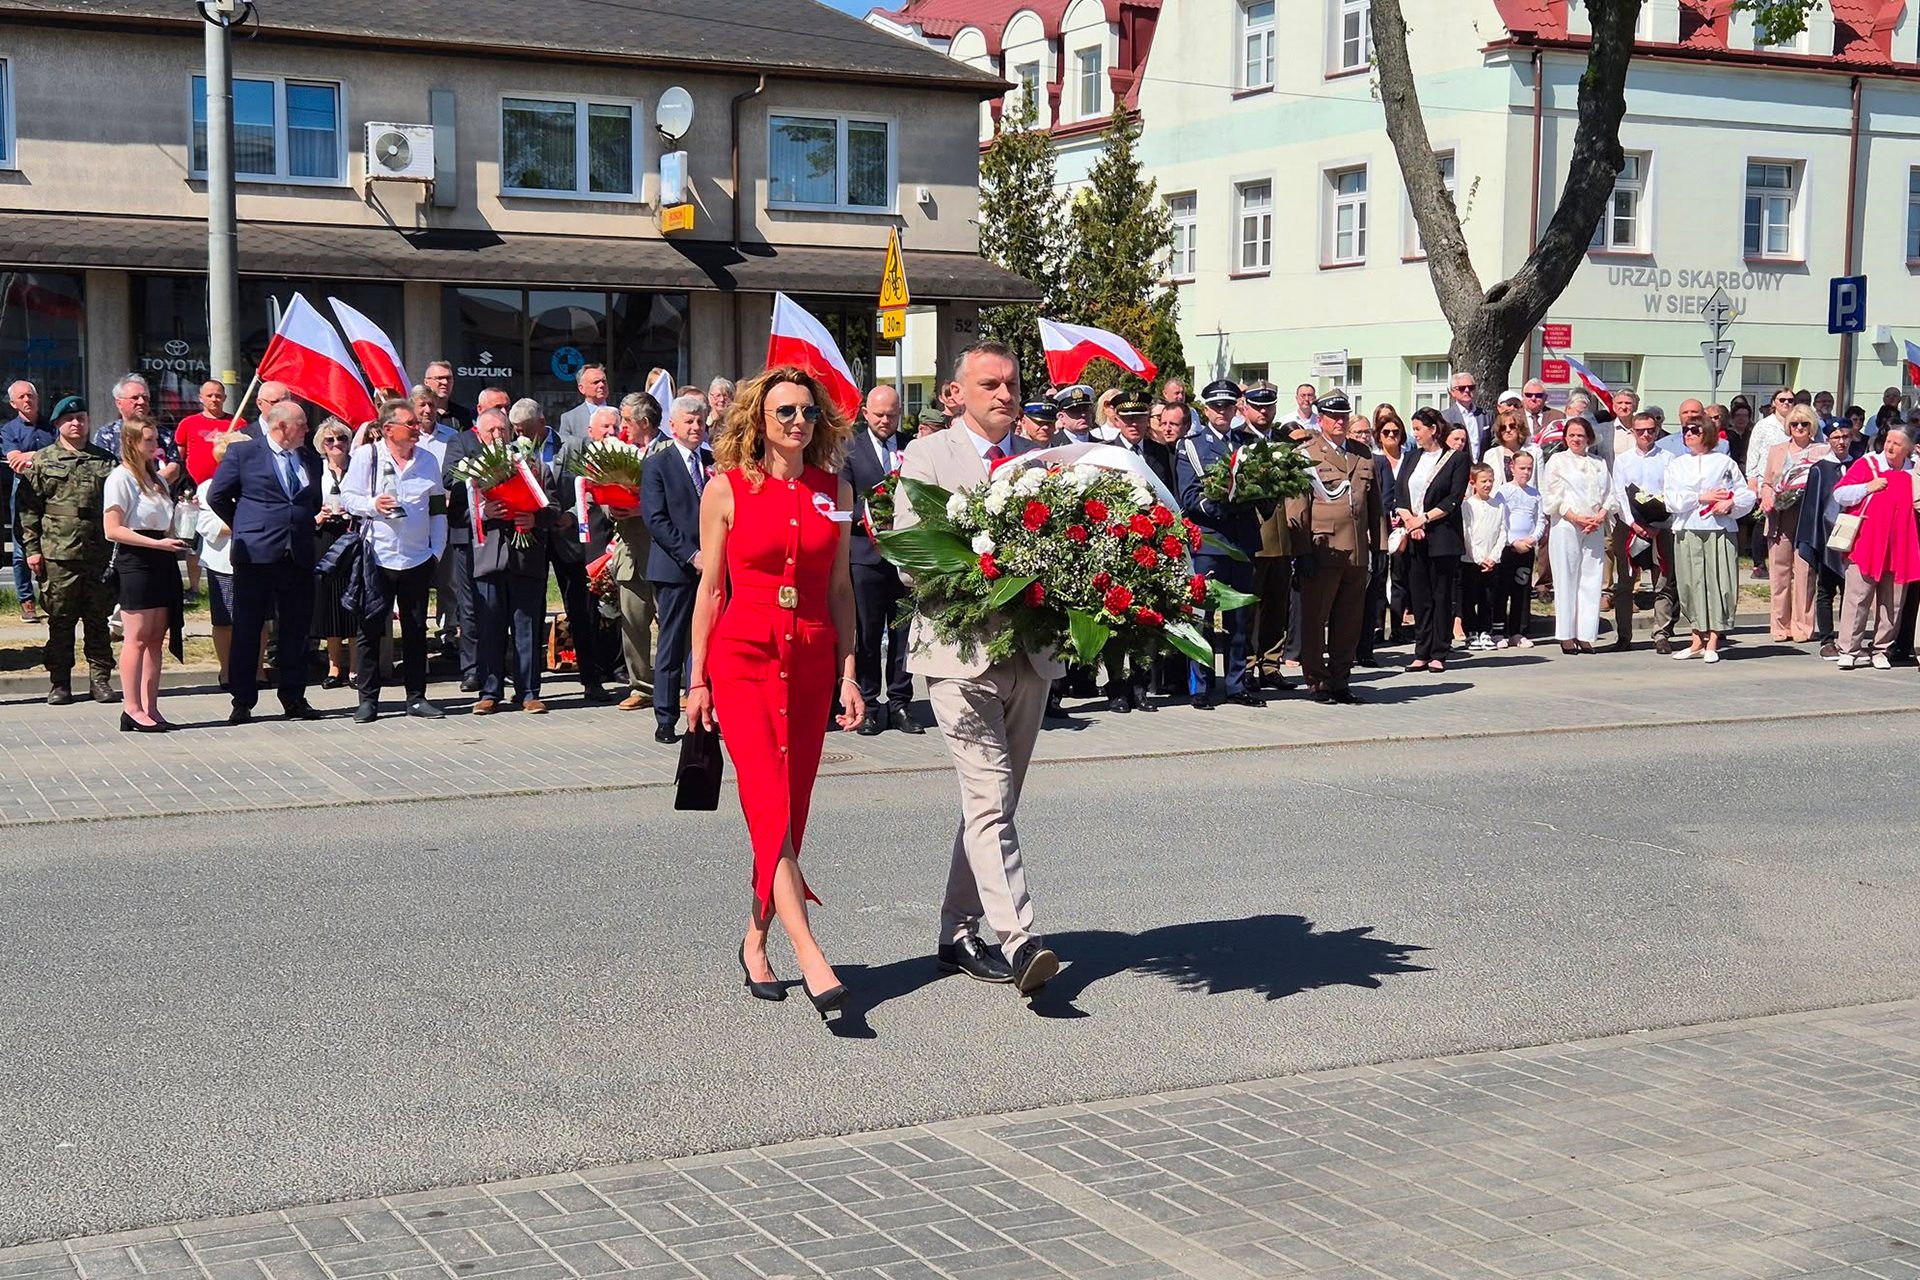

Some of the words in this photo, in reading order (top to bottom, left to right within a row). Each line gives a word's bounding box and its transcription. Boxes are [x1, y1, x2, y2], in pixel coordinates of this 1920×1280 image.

[1608, 267, 1672, 291] URZĄD
[1677, 269, 1785, 291] SKARBOWY
[1644, 293, 1662, 313] W
[1836, 283, 1857, 327] P
[954, 318, 973, 333] 52
[142, 358, 207, 371] TOYOTA
[457, 366, 513, 378] SUZUKI
